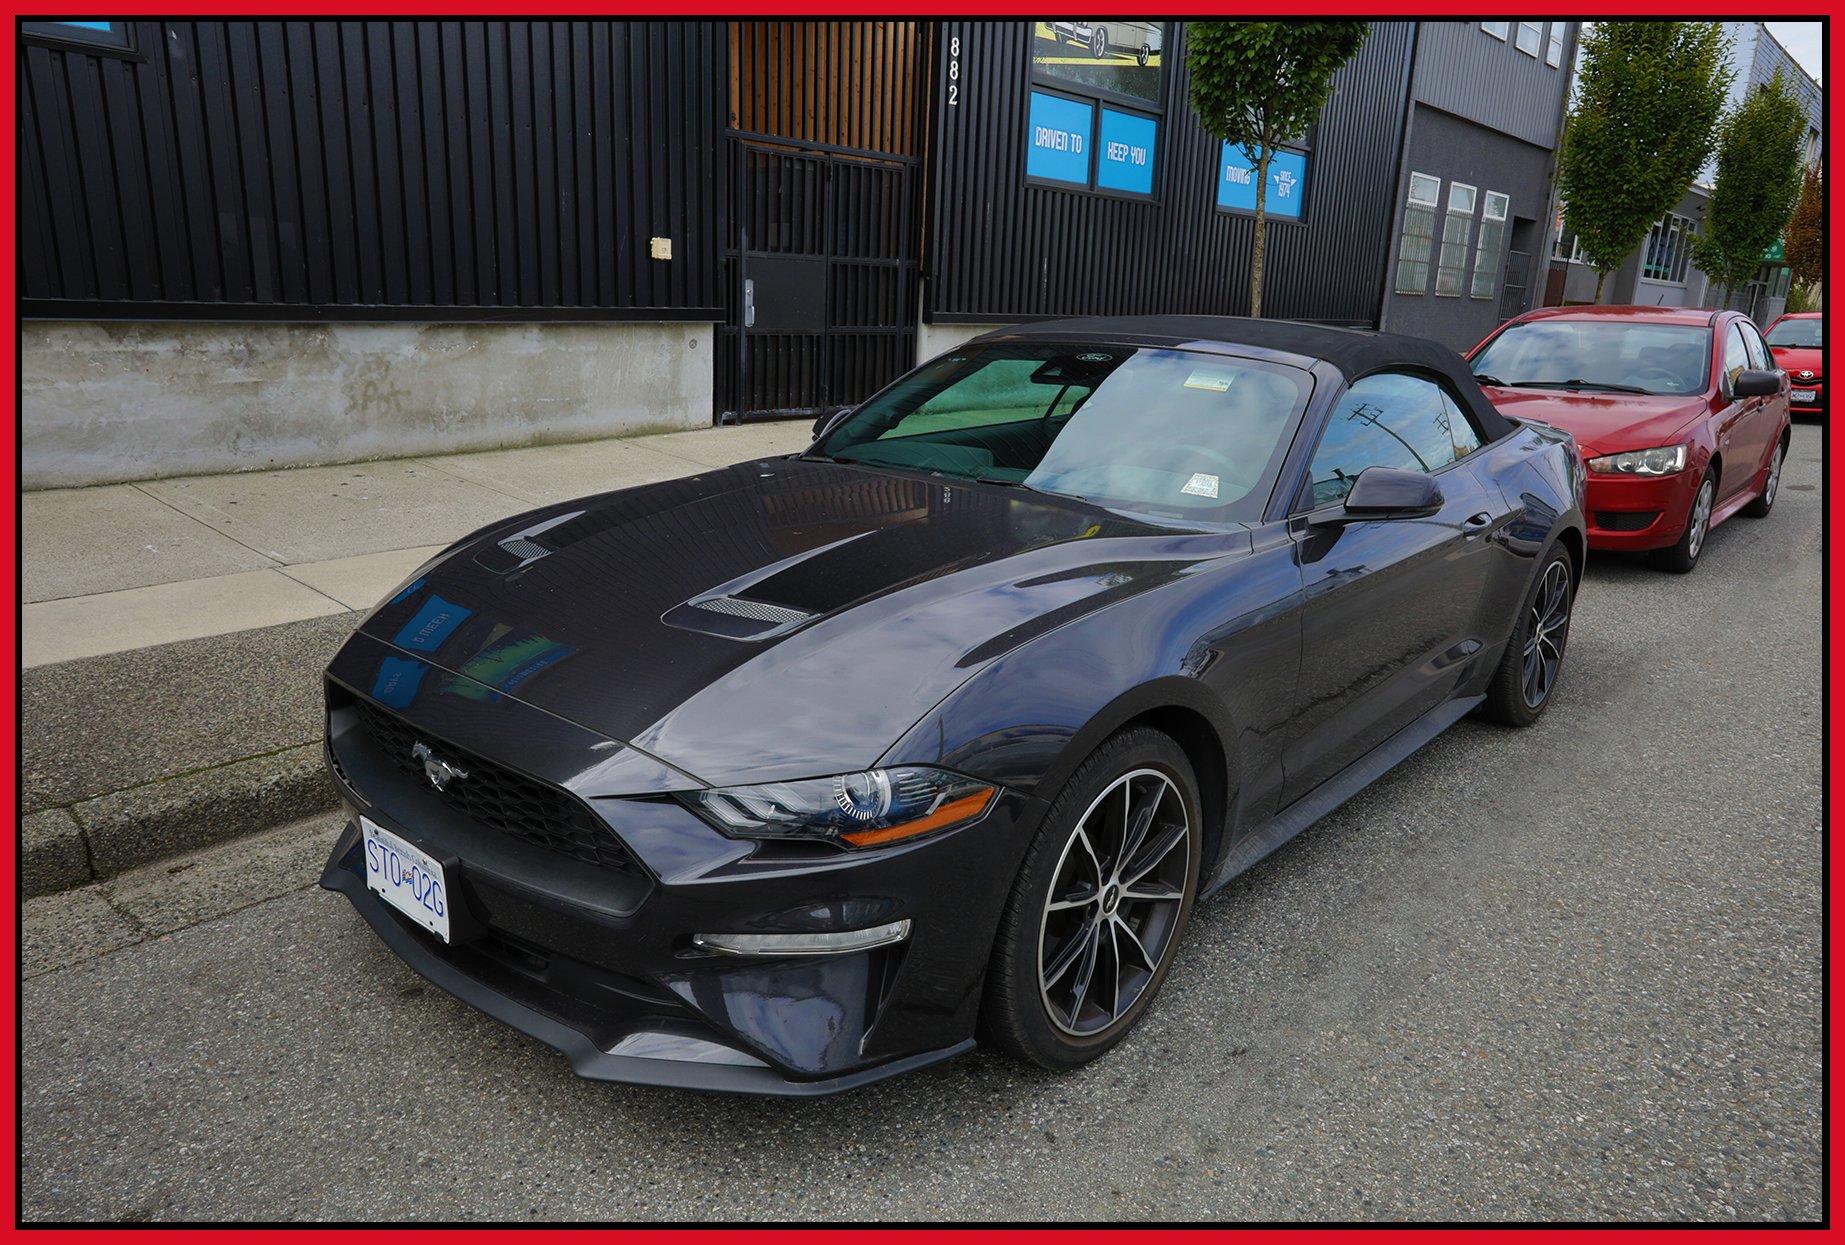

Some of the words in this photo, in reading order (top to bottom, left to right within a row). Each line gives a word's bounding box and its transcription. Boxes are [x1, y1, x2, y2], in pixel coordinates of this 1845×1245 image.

[1035, 126, 1069, 152] DRIVEN
[1070, 133, 1083, 154] TO
[1107, 141, 1129, 162] KEEP
[1130, 146, 1146, 166] YOU
[1279, 170, 1292, 183] SINCE
